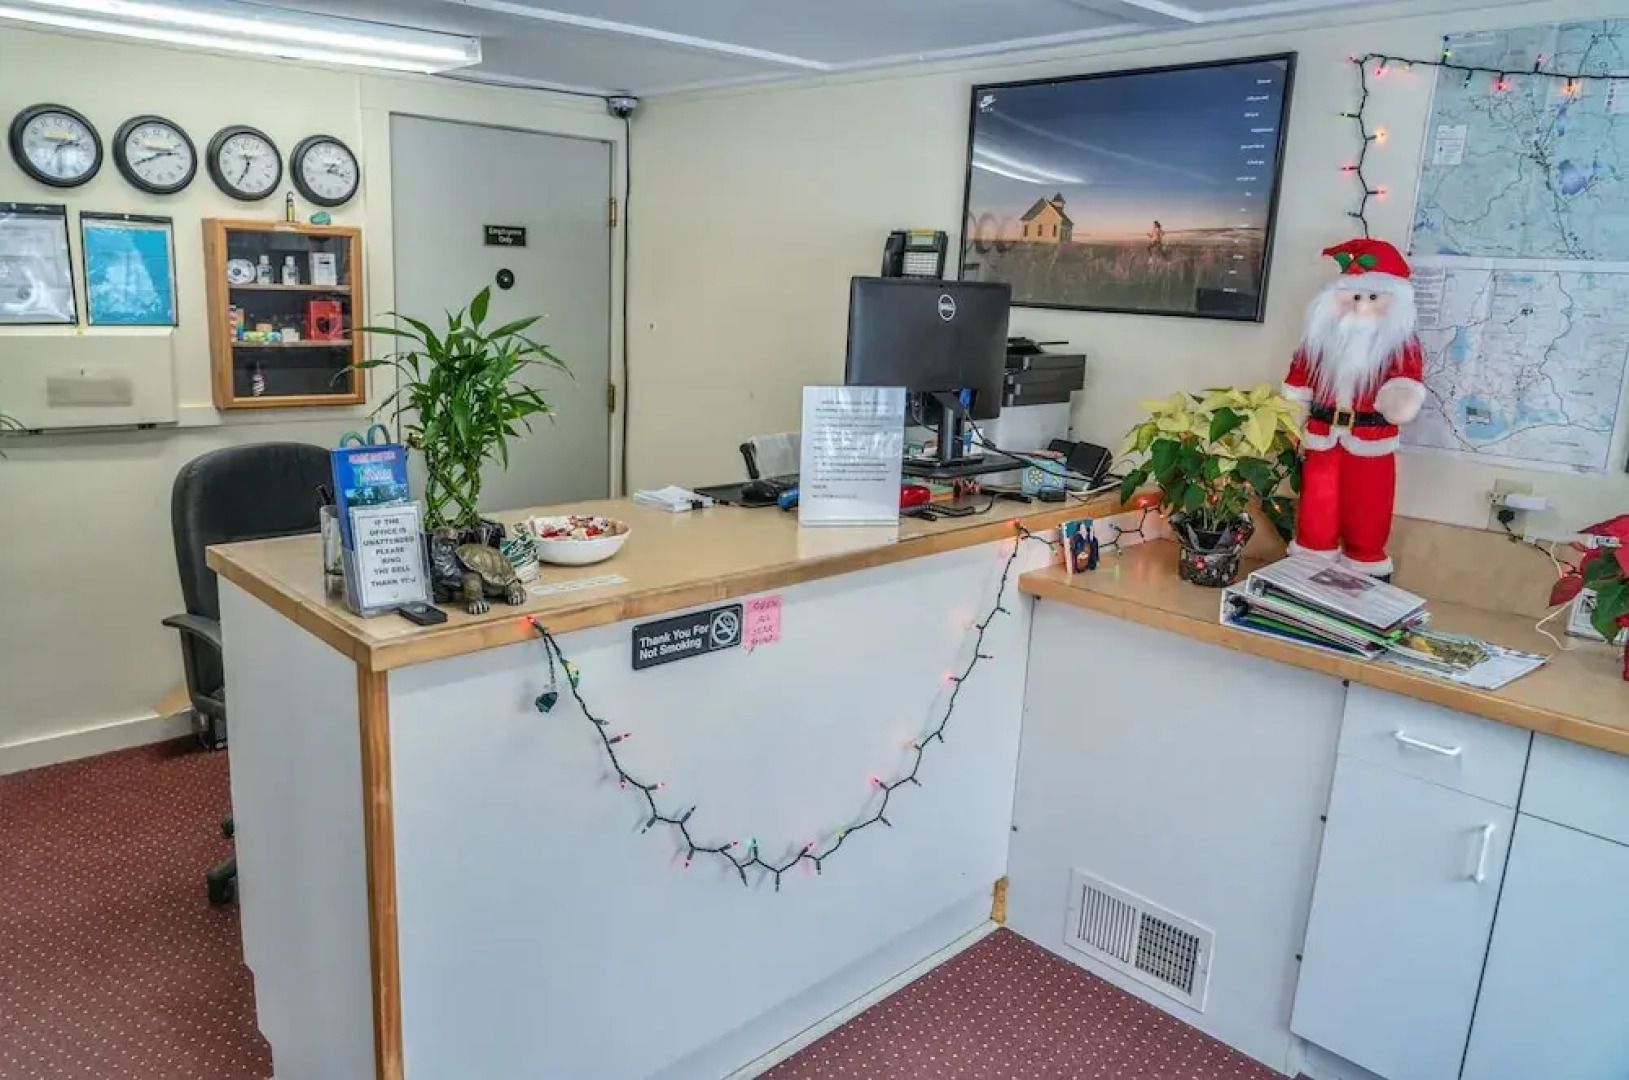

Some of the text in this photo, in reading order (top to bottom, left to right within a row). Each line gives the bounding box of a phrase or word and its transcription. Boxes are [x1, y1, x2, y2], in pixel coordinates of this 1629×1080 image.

[488, 227, 522, 237] Emply
[384, 517, 400, 525] THE
[369, 529, 397, 537] OFFICE
[363, 535, 415, 546] UNATTENDED
[375, 546, 405, 556] PLEASE
[374, 565, 410, 575] THE BELL
[370, 579, 398, 587] THANK
[639, 622, 710, 648] Thank You For
[639, 637, 703, 660] Not Smoking
